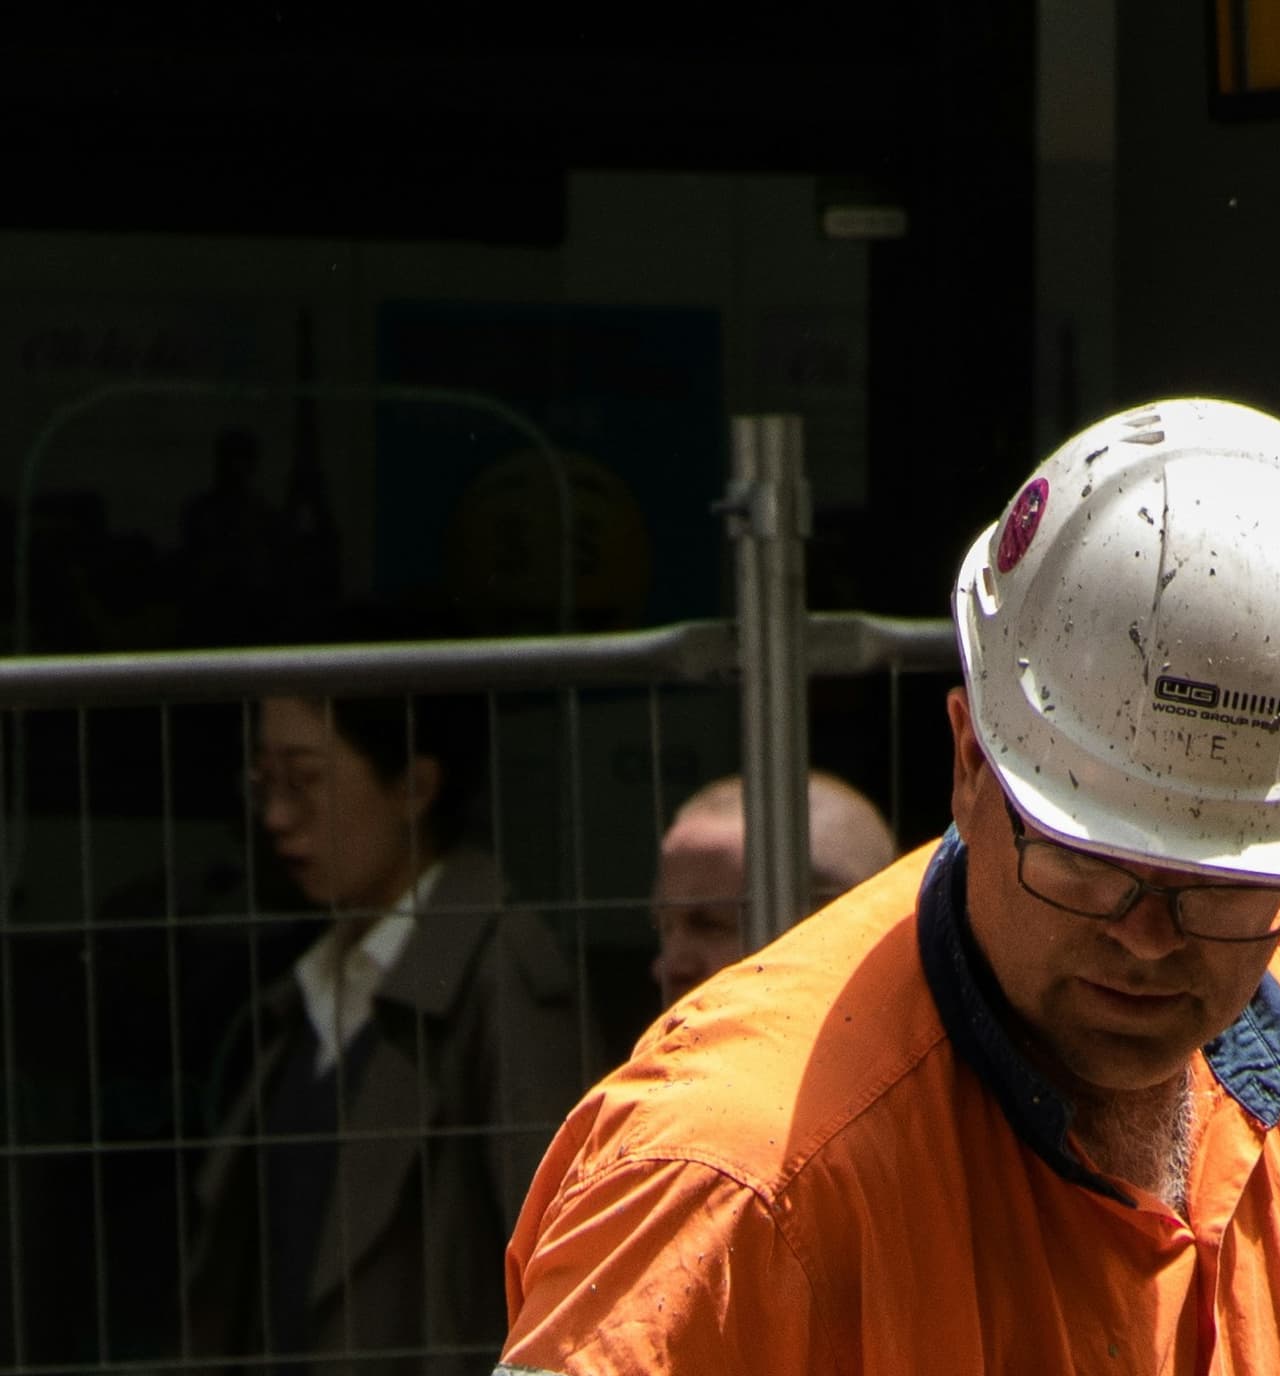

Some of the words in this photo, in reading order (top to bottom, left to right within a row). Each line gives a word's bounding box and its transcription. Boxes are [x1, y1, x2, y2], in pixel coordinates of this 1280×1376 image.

[1159, 679, 1215, 704] WG
[1151, 702, 1198, 718] WOOD
[1200, 711, 1249, 726] GROUP
